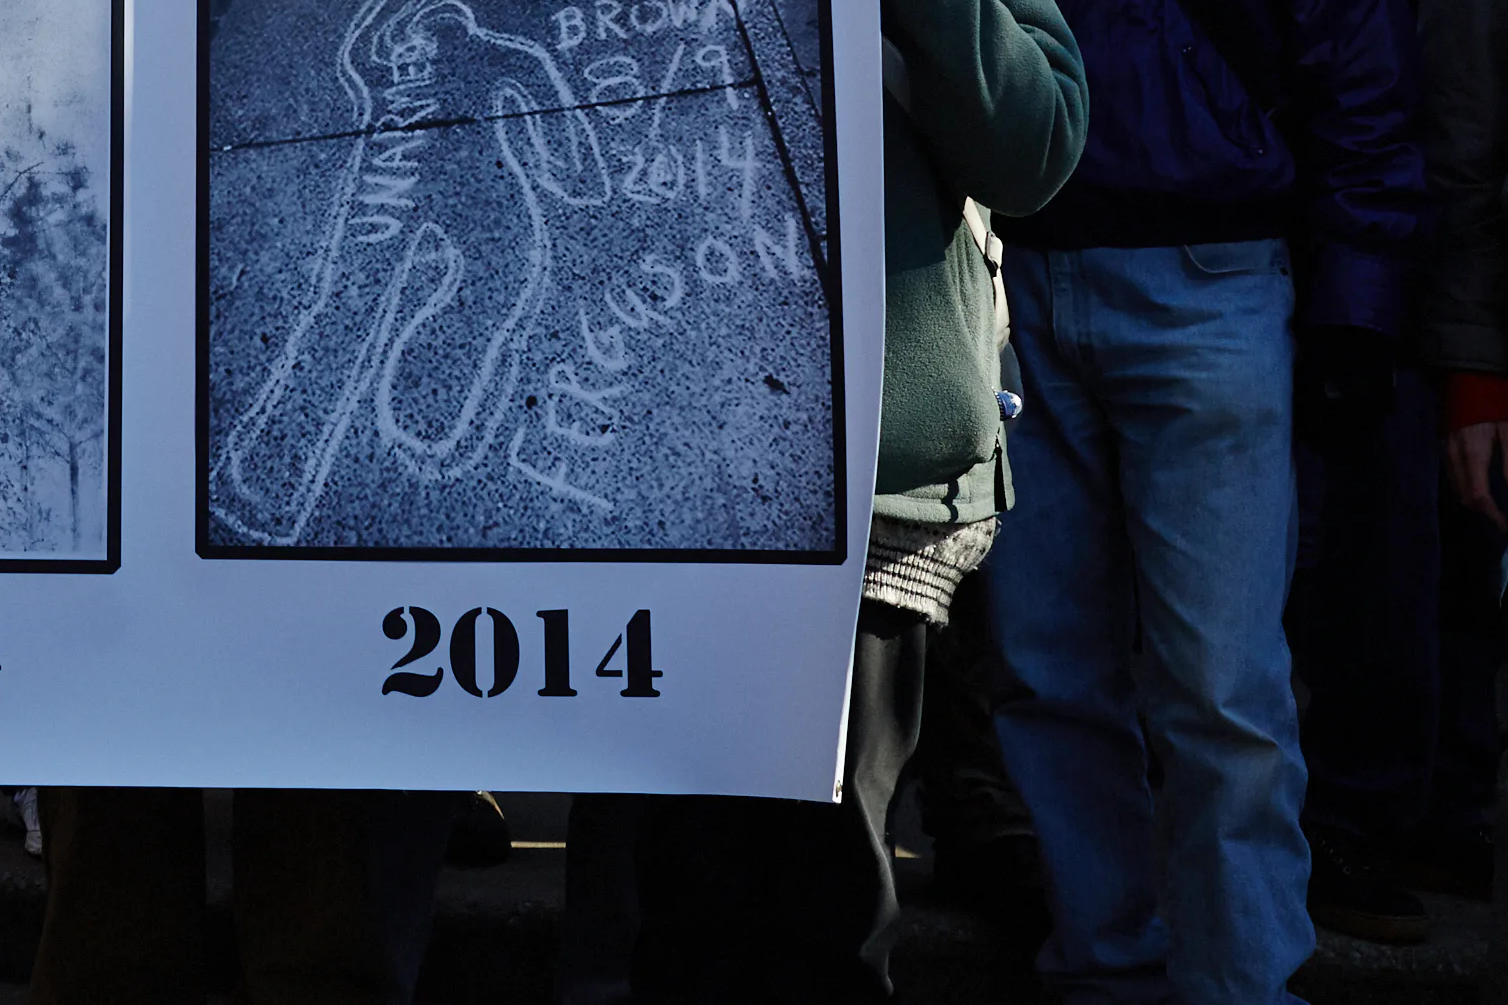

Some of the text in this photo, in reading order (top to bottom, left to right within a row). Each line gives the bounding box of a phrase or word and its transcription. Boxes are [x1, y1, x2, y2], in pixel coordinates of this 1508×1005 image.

[622, 124, 766, 224] 2014
[509, 217, 802, 512] FERGUSON
[381, 605, 664, 699] 2014
